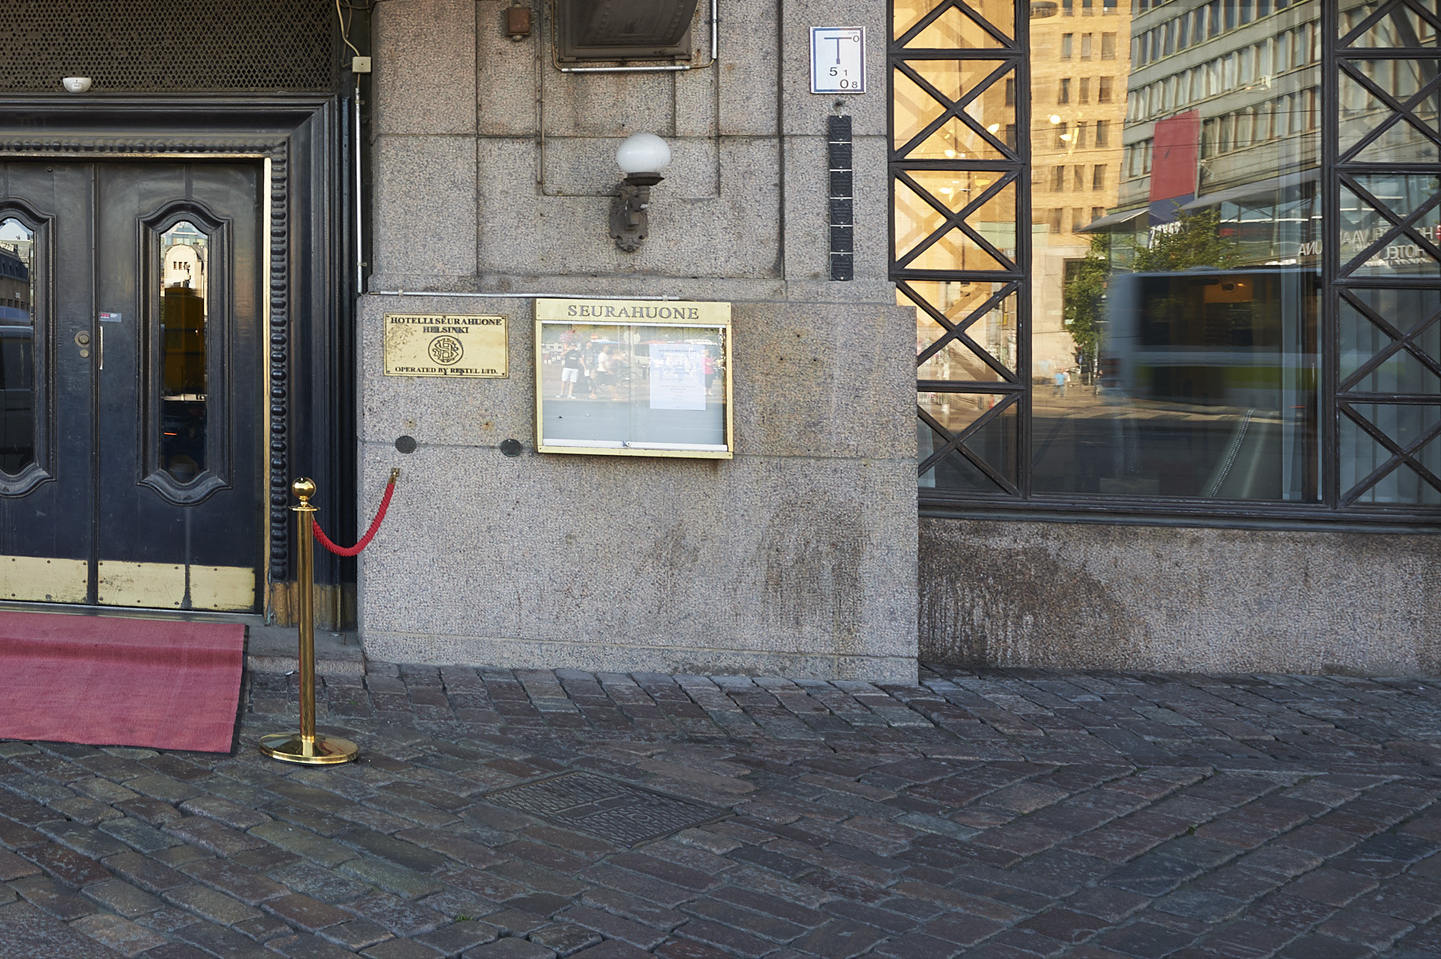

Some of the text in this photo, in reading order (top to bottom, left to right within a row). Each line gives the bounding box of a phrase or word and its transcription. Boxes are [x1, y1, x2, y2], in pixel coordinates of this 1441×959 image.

[567, 304, 700, 320] SEURAHUONE
[390, 317, 502, 326] HOTELLI SEURAHUONE
[422, 326, 469, 334] HELSINKI
